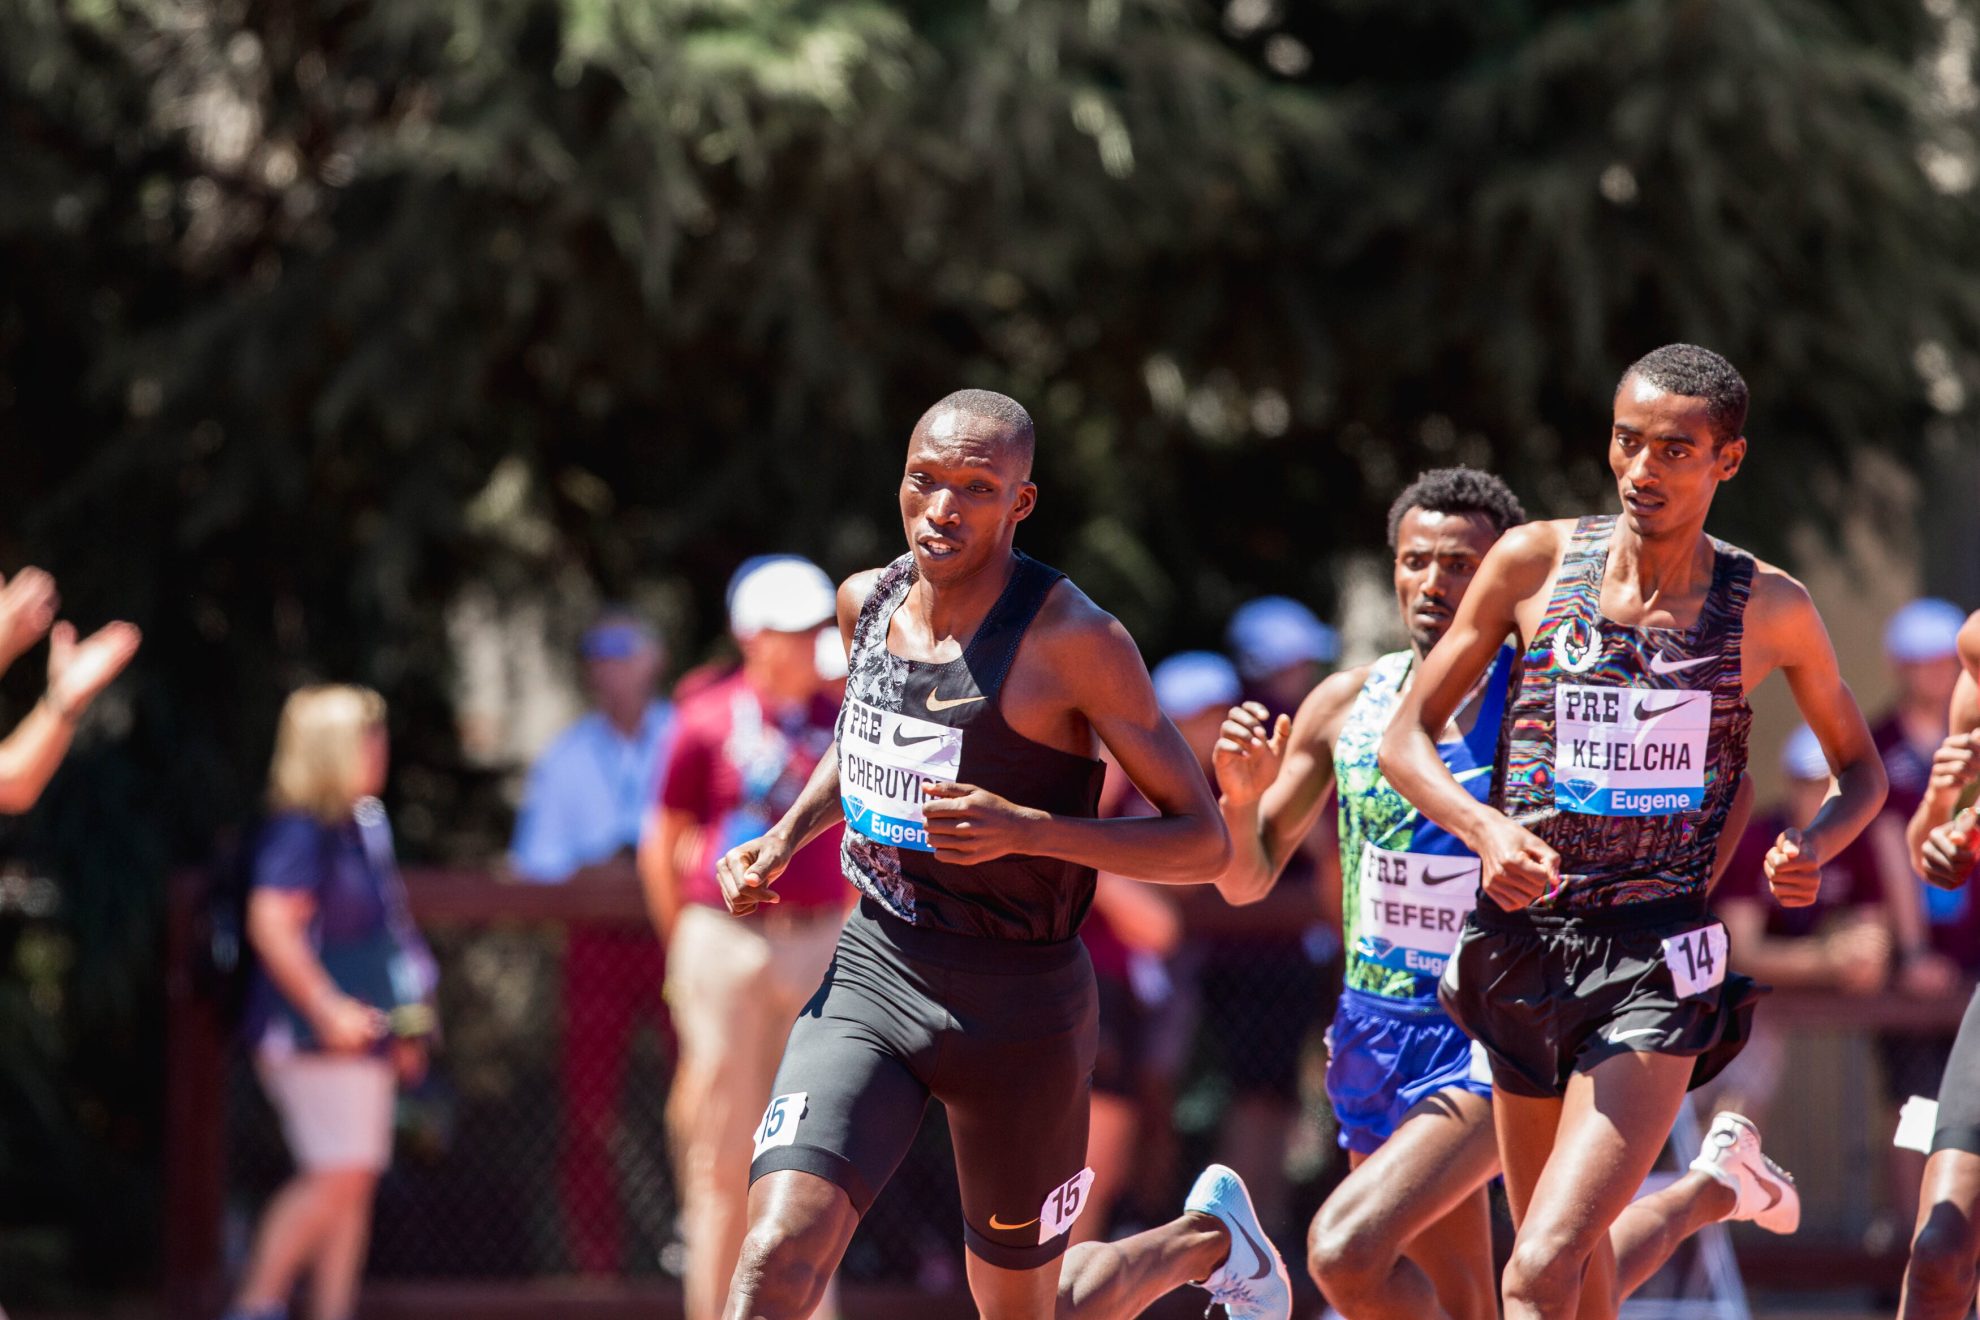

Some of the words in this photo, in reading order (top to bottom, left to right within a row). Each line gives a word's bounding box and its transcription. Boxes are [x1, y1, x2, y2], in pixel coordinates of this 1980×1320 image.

[850, 703, 882, 745] PRE
[1566, 691, 1619, 723] PRE
[1573, 738, 1691, 771] KEJELCHA
[848, 753, 942, 804] CHERUYI
[1611, 791, 1690, 813] Eugene
[871, 814, 932, 844] Eugen
[1405, 951, 1449, 977] Eug
[1678, 930, 1714, 981] 14
[761, 1097, 789, 1144] 15
[1052, 1173, 1081, 1225] 15
